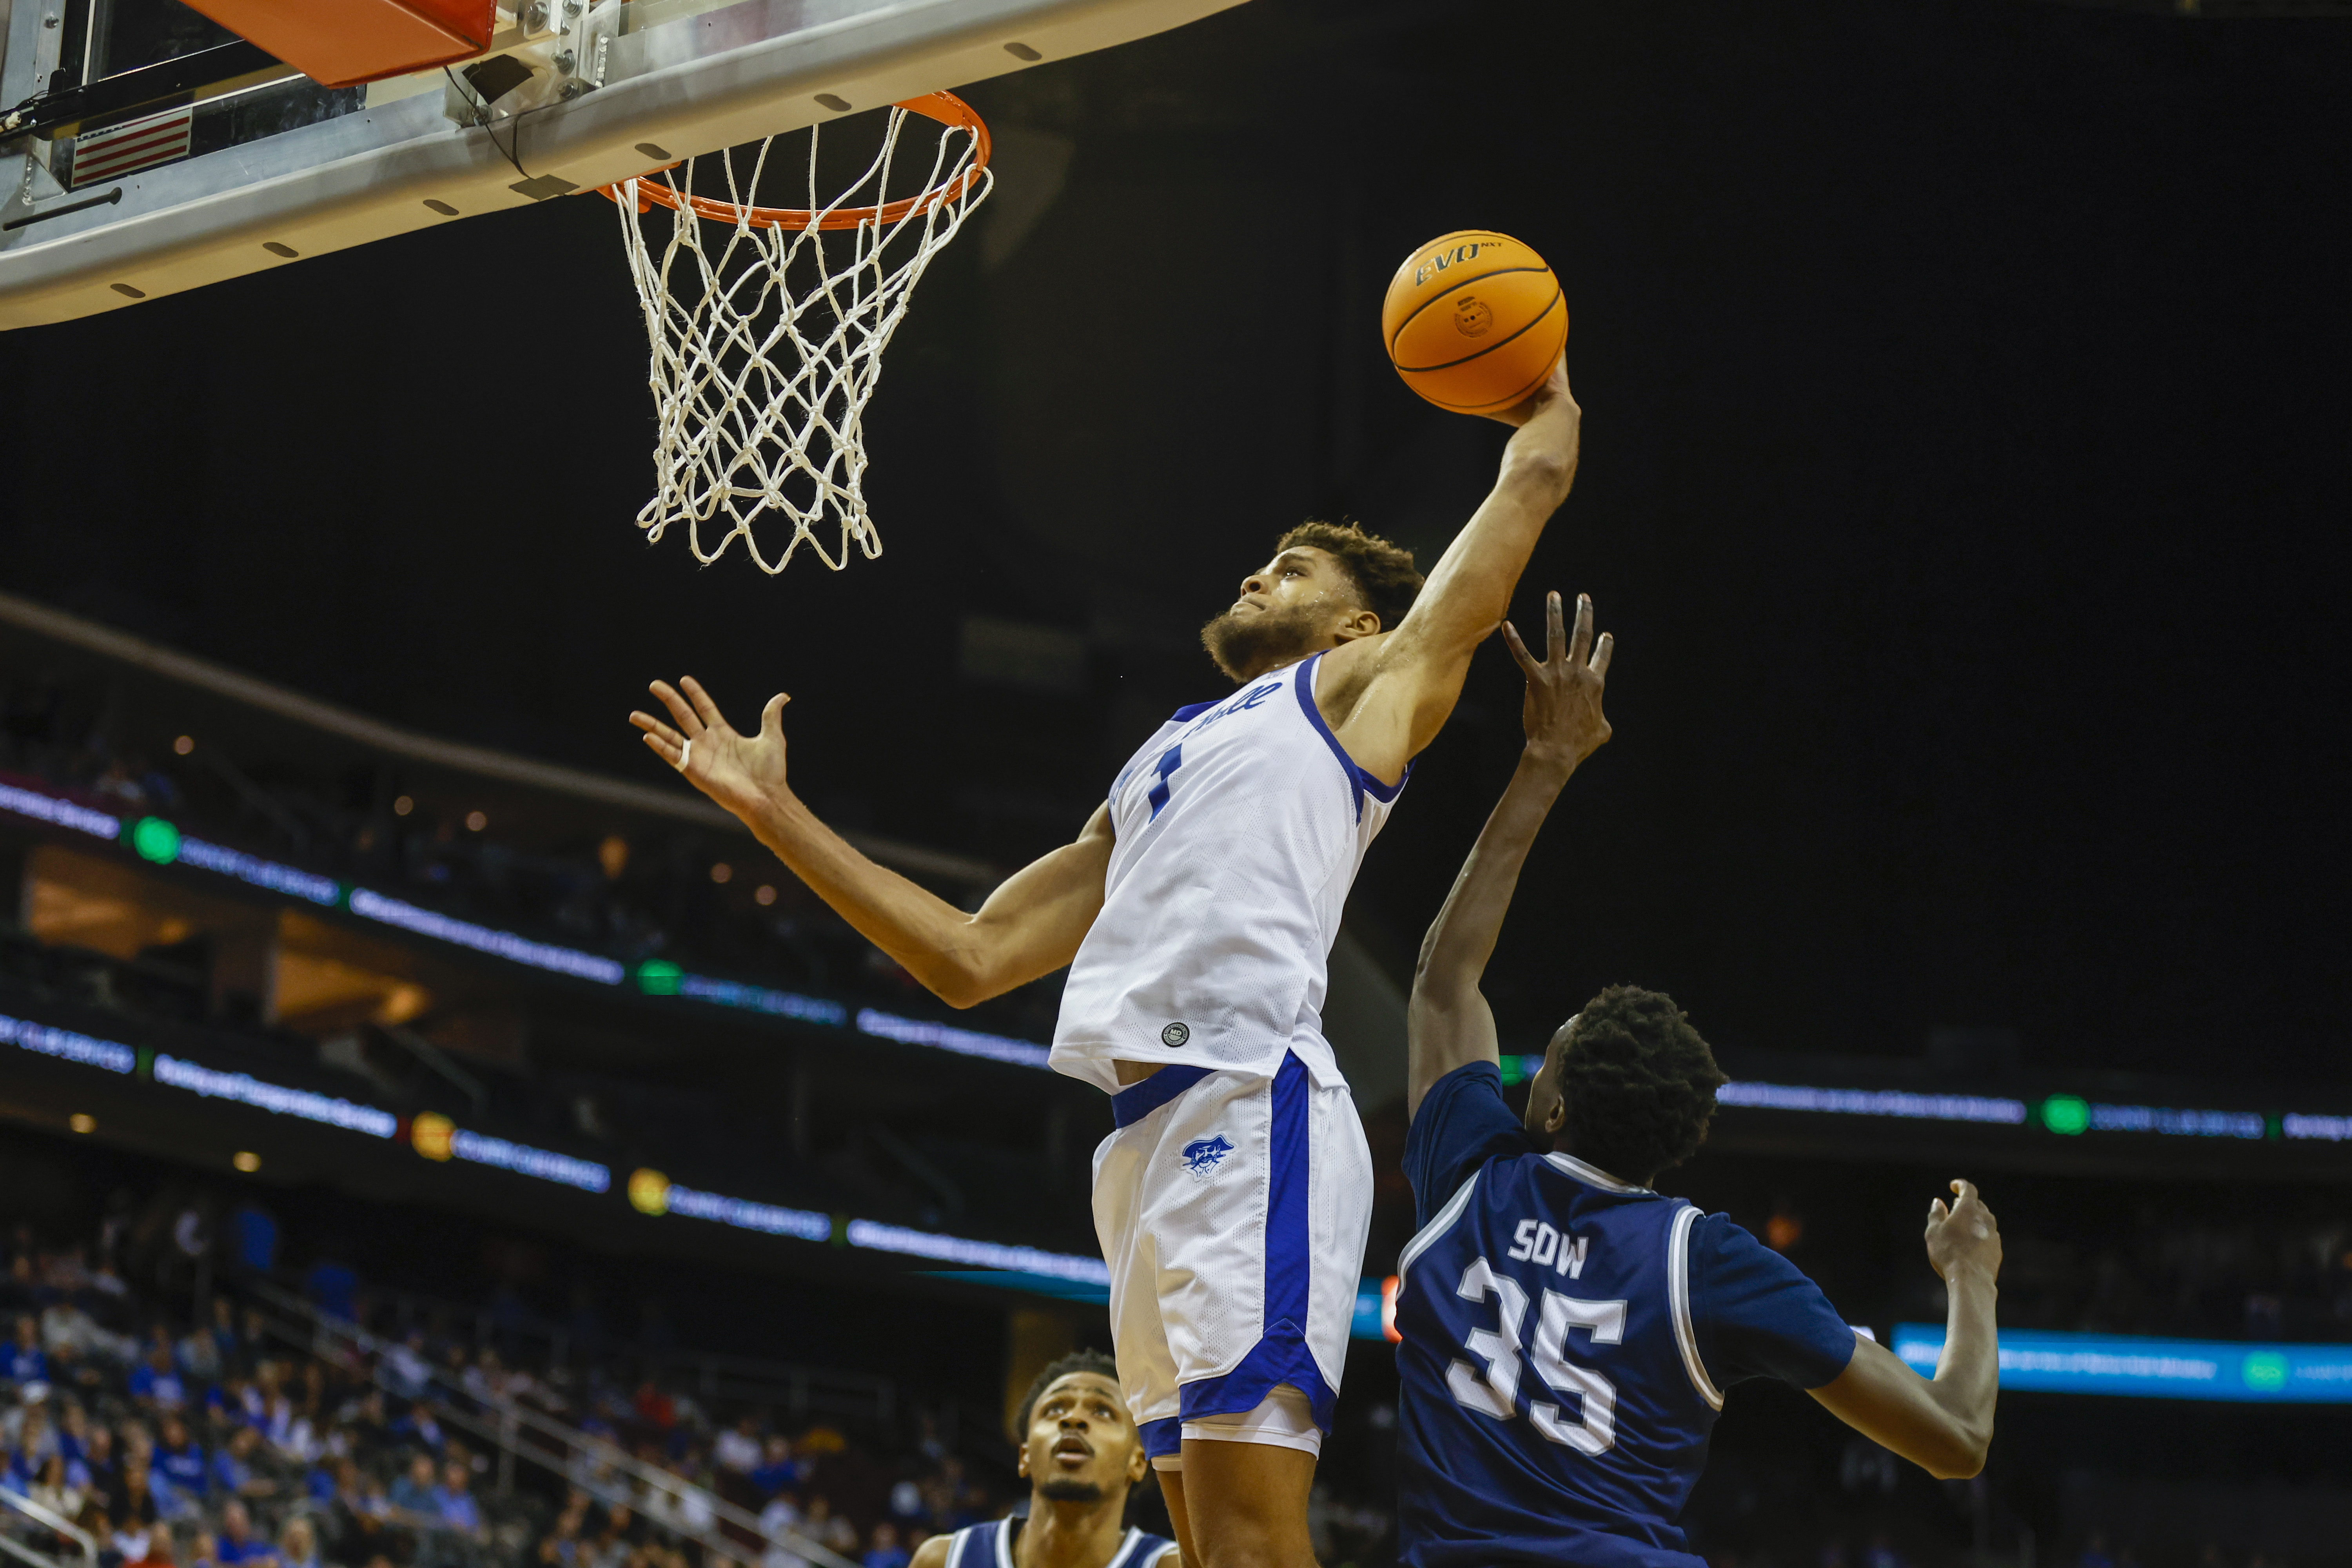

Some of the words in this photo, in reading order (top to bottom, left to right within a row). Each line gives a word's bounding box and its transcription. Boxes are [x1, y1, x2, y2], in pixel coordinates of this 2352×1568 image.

[1416, 243, 1479, 287] EVO
[1148, 742, 1182, 825] 1
[1507, 1219, 1589, 1280] SOW
[1445, 1256, 1628, 1457] 35
